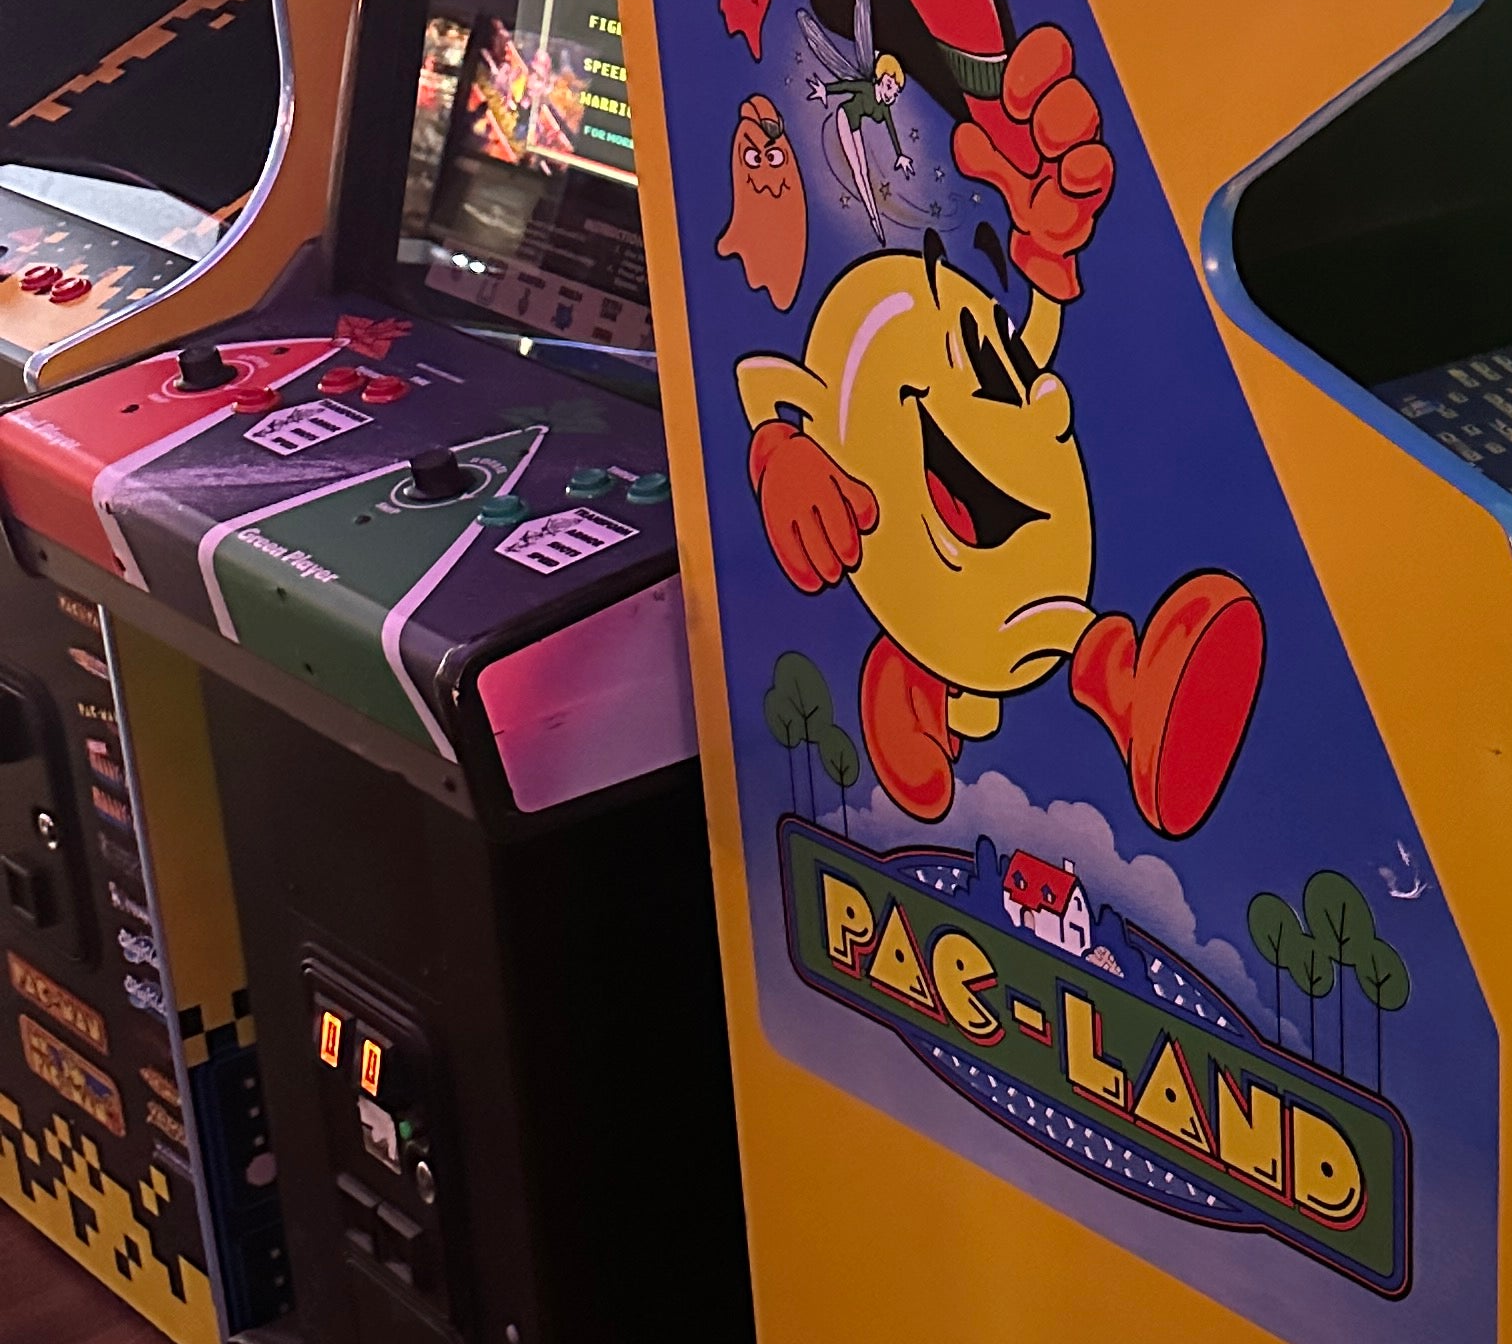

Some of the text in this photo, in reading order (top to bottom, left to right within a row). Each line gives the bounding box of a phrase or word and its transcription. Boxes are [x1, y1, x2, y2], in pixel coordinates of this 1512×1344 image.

[238, 528, 339, 582] Green Player
[815, 859, 1368, 1231] PAC-LAND
